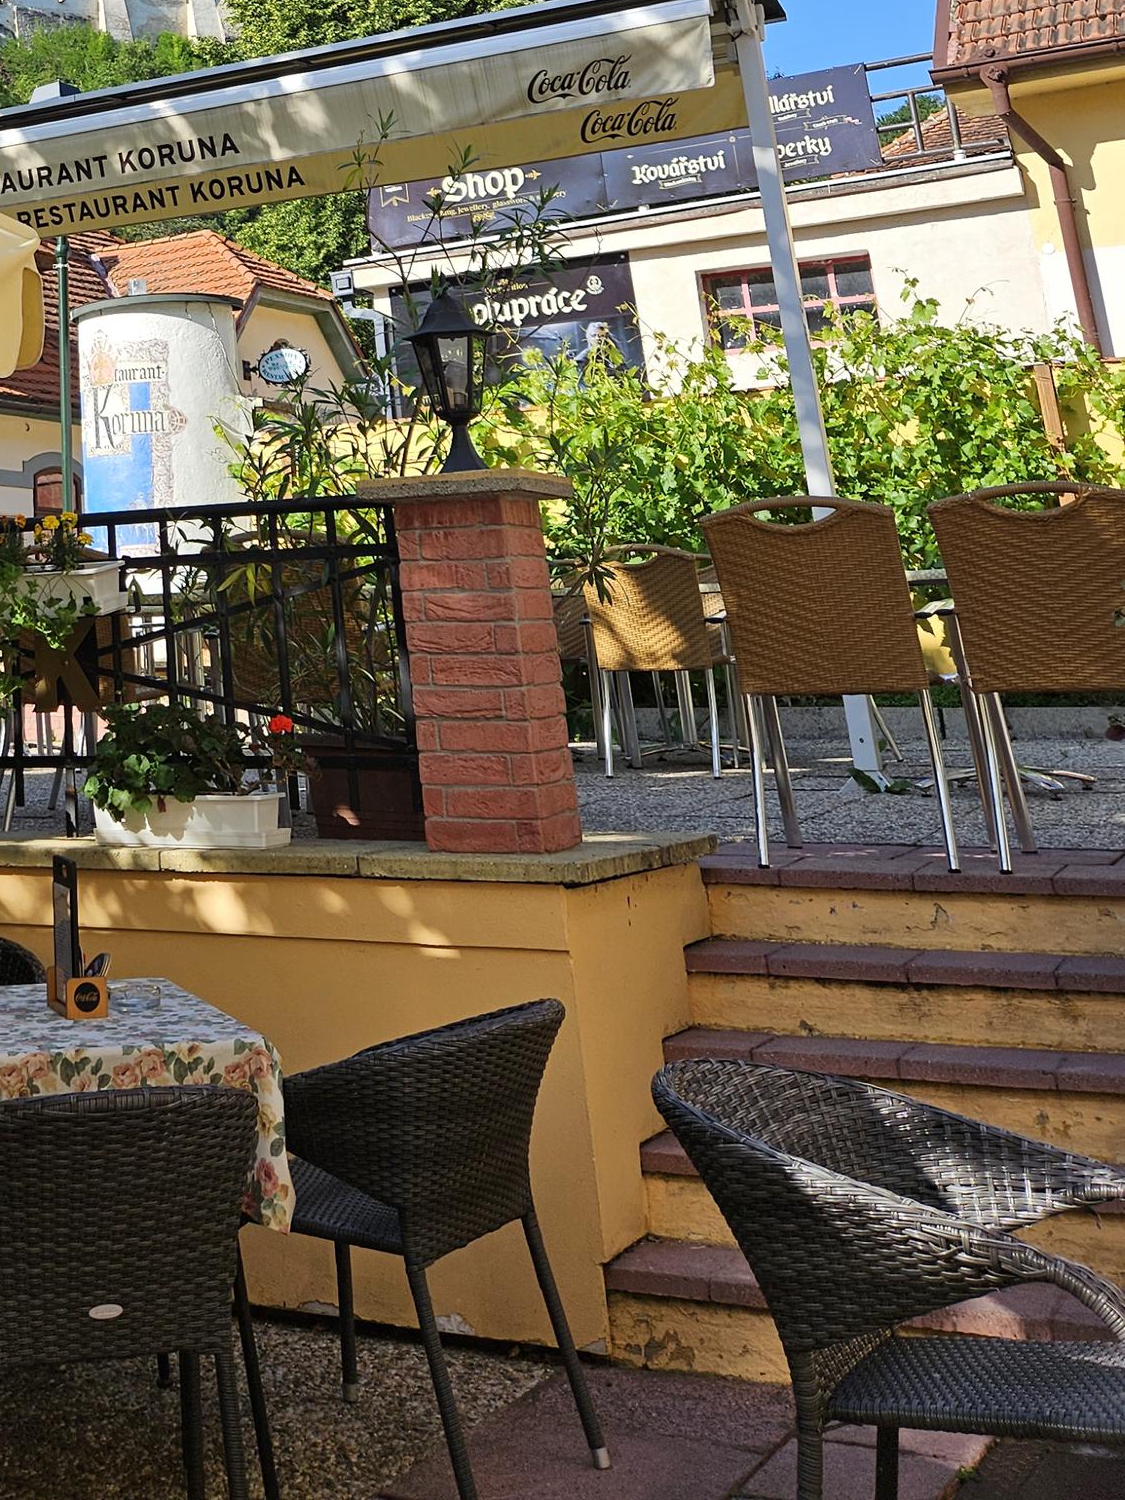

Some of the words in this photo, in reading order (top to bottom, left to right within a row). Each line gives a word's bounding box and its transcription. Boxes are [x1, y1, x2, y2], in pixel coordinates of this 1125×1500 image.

[527, 53, 632, 103] Coca-Cola
[580, 95, 679, 144] Coca-Cola
[118, 133, 241, 173] KORUNA
[777, 135, 832, 158] perky
[441, 167, 525, 202] Shop
[631, 149, 726, 185] Kovářství
[17, 185, 180, 229] RESTAURANT
[190, 165, 305, 201] KORUNA
[472, 287, 588, 326] olupráce
[92, 384, 165, 449] Koruna
